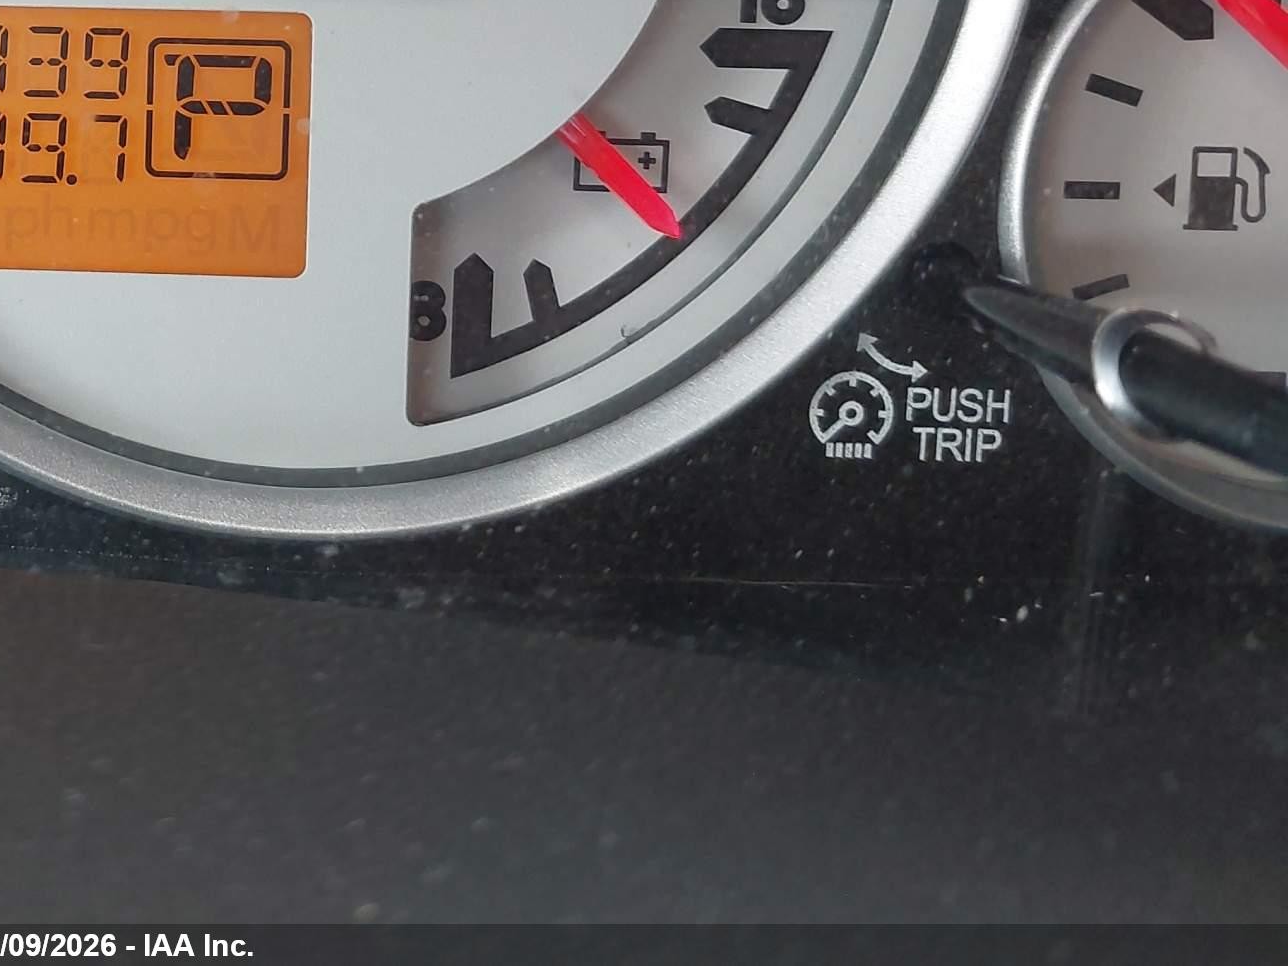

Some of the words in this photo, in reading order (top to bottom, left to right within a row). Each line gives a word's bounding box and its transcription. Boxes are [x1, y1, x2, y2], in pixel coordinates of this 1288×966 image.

[163, 54, 273, 161] P
[410, 280, 447, 341] 8
[906, 387, 1011, 424] PUSH
[913, 426, 1002, 463] TRIP
